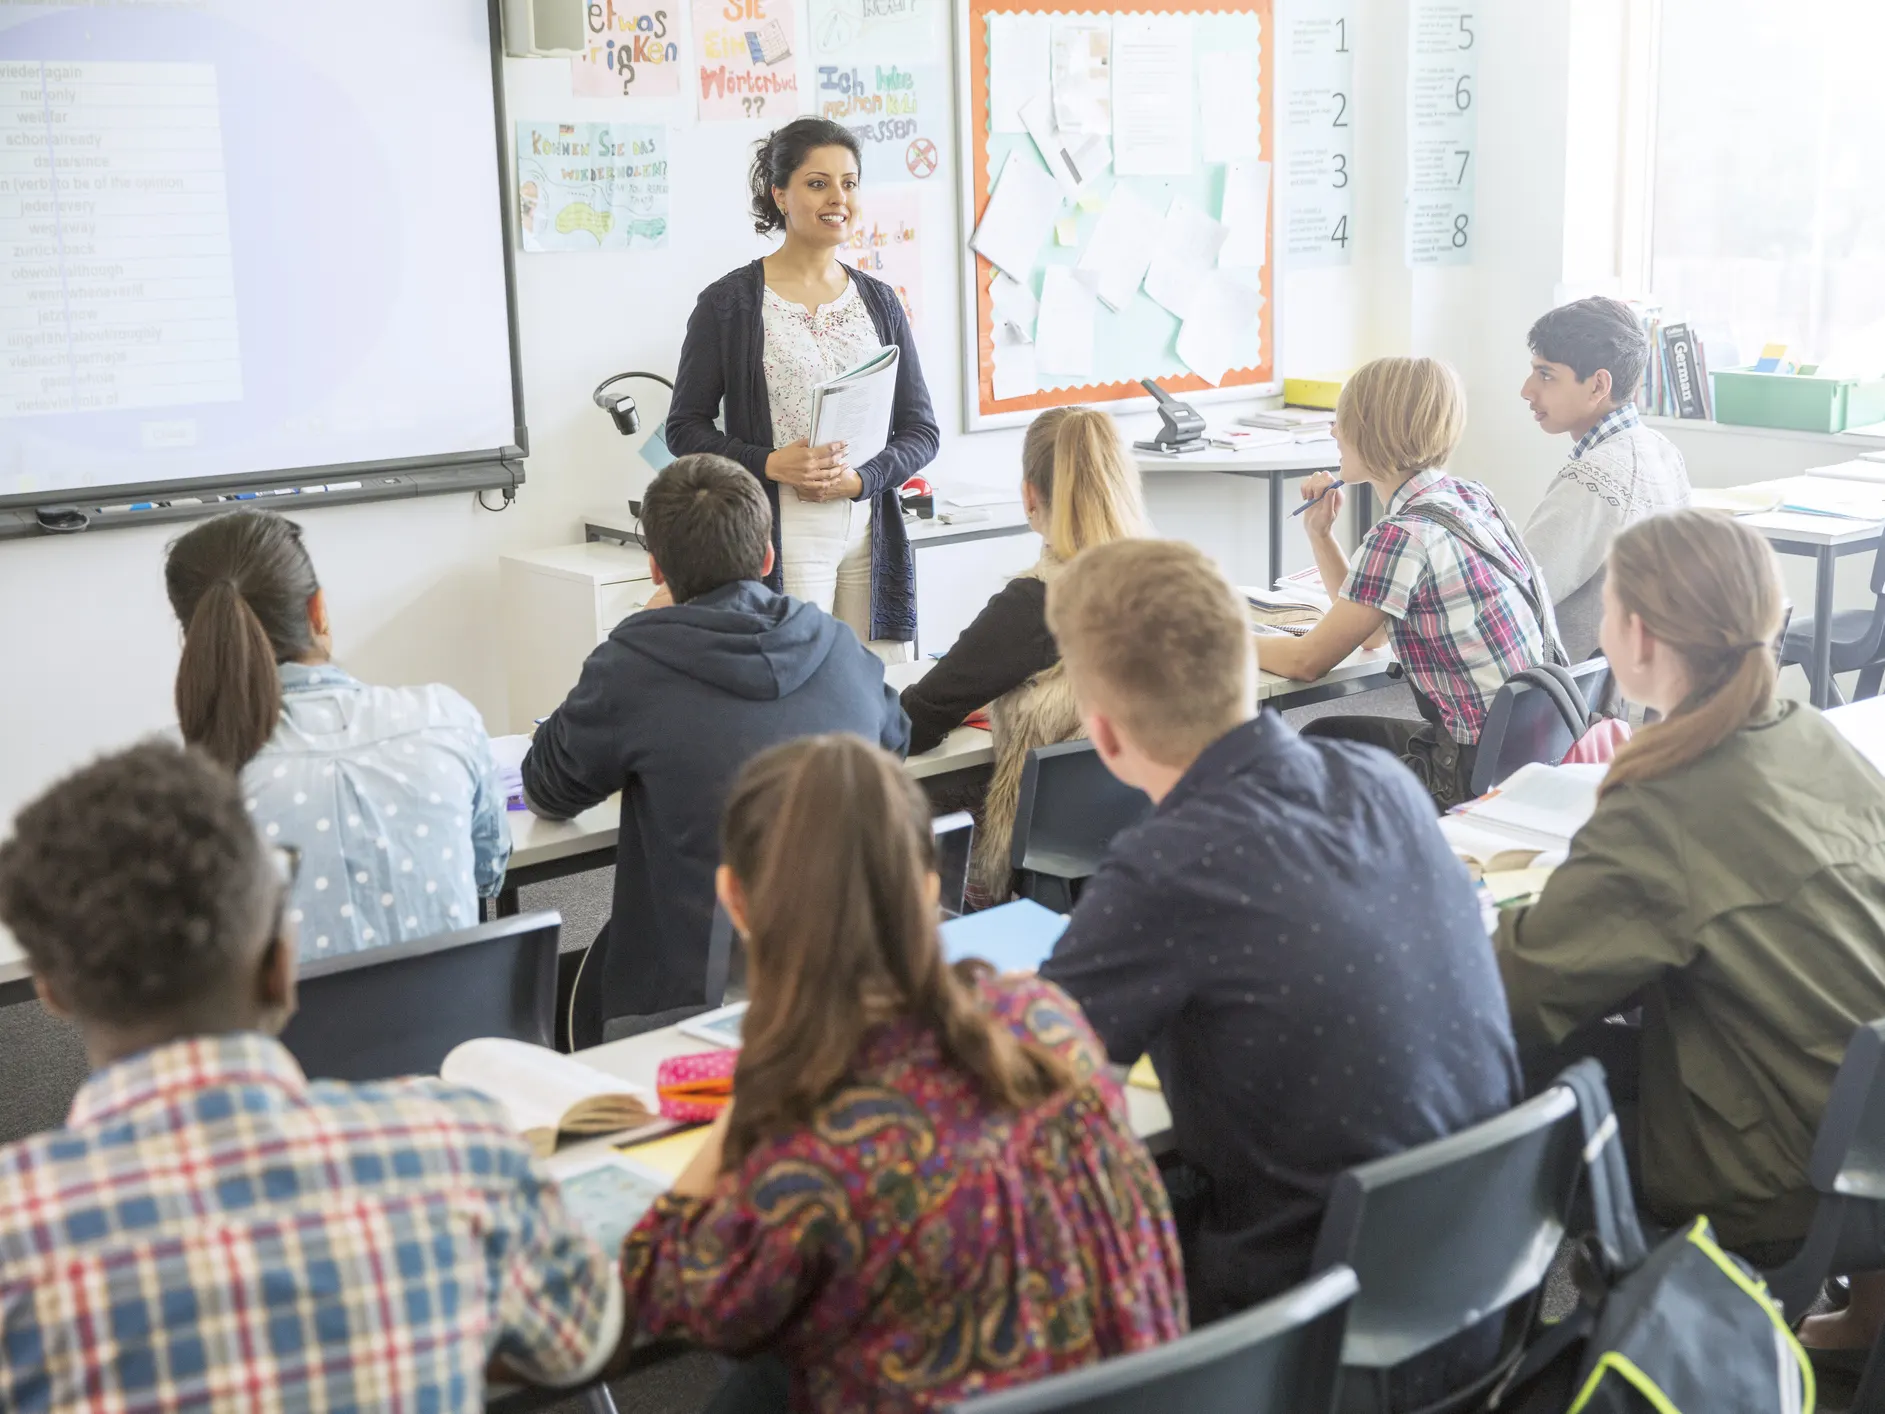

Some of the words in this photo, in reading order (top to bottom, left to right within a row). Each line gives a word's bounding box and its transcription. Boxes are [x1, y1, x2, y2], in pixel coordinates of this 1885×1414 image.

[1336, 17, 1349, 53] 1
[1458, 14, 1474, 50] 5
[44, 66, 83, 82] again
[818, 66, 865, 97] Ich
[47, 87, 76, 105] only
[1332, 92, 1349, 128] 2
[1456, 74, 1471, 111] 6
[49, 109, 68, 123] far
[6, 132, 48, 146] schon
[50, 132, 102, 149] already
[1332, 153, 1349, 189] 3
[1454, 150, 1471, 186] 7
[1330, 214, 1349, 249] 4
[1452, 213, 1469, 248] 8
[1673, 341, 1692, 402] German
